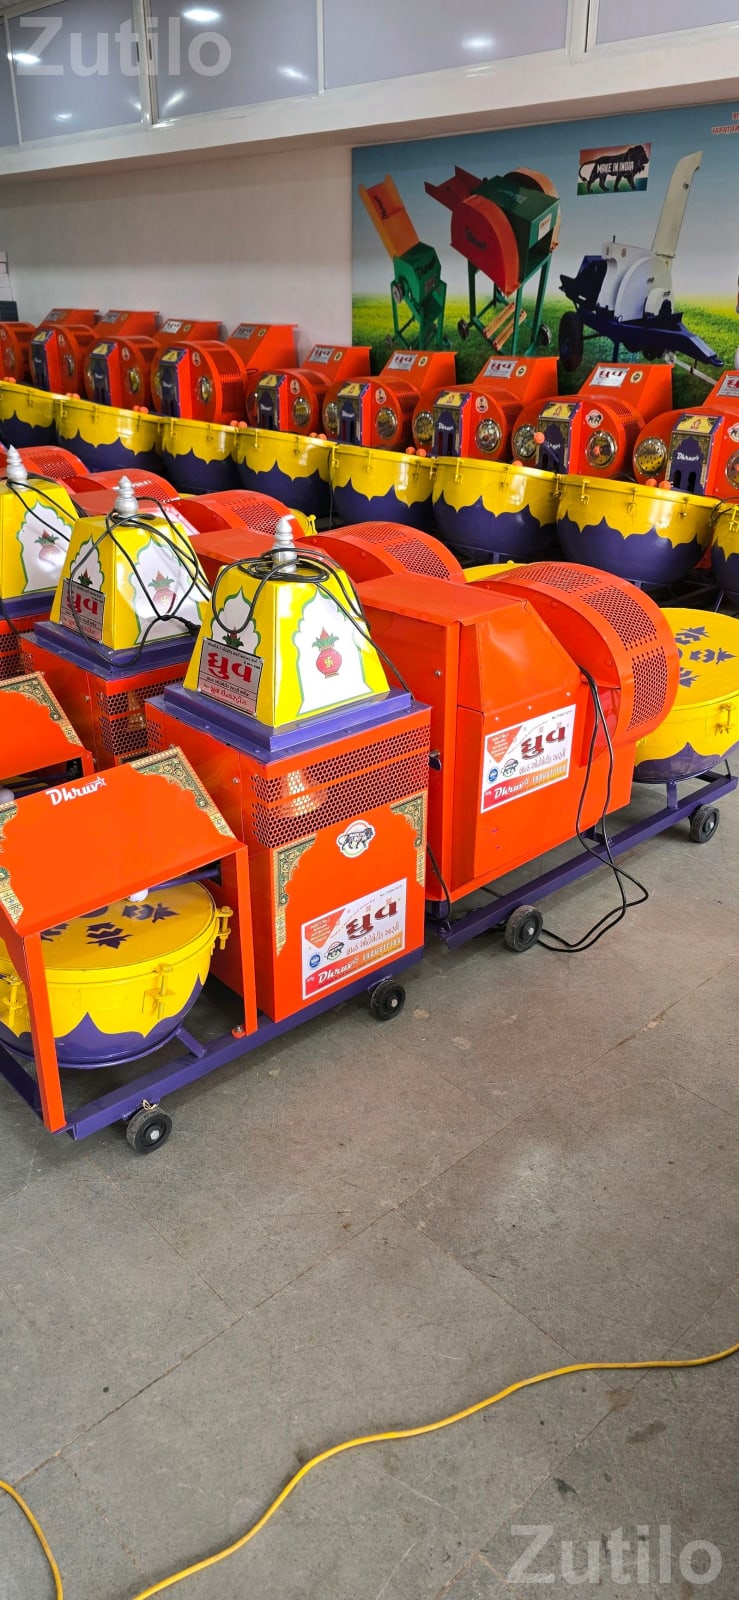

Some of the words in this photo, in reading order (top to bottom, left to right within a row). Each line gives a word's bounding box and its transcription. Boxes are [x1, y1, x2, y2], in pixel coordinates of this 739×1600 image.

[597, 163, 612, 173] MAKE
[612, 162, 619, 172] IN
[619, 161, 634, 172] INDIA
[207, 652, 252, 683] ધ્રુવ
[521, 727, 566, 760] ધ્રુવ
[45, 779, 100, 806] Dhruv
[494, 781, 525, 799] Dhruv
[346, 901, 398, 940] ધ્રુવ
[318, 961, 355, 984] Dhruv
